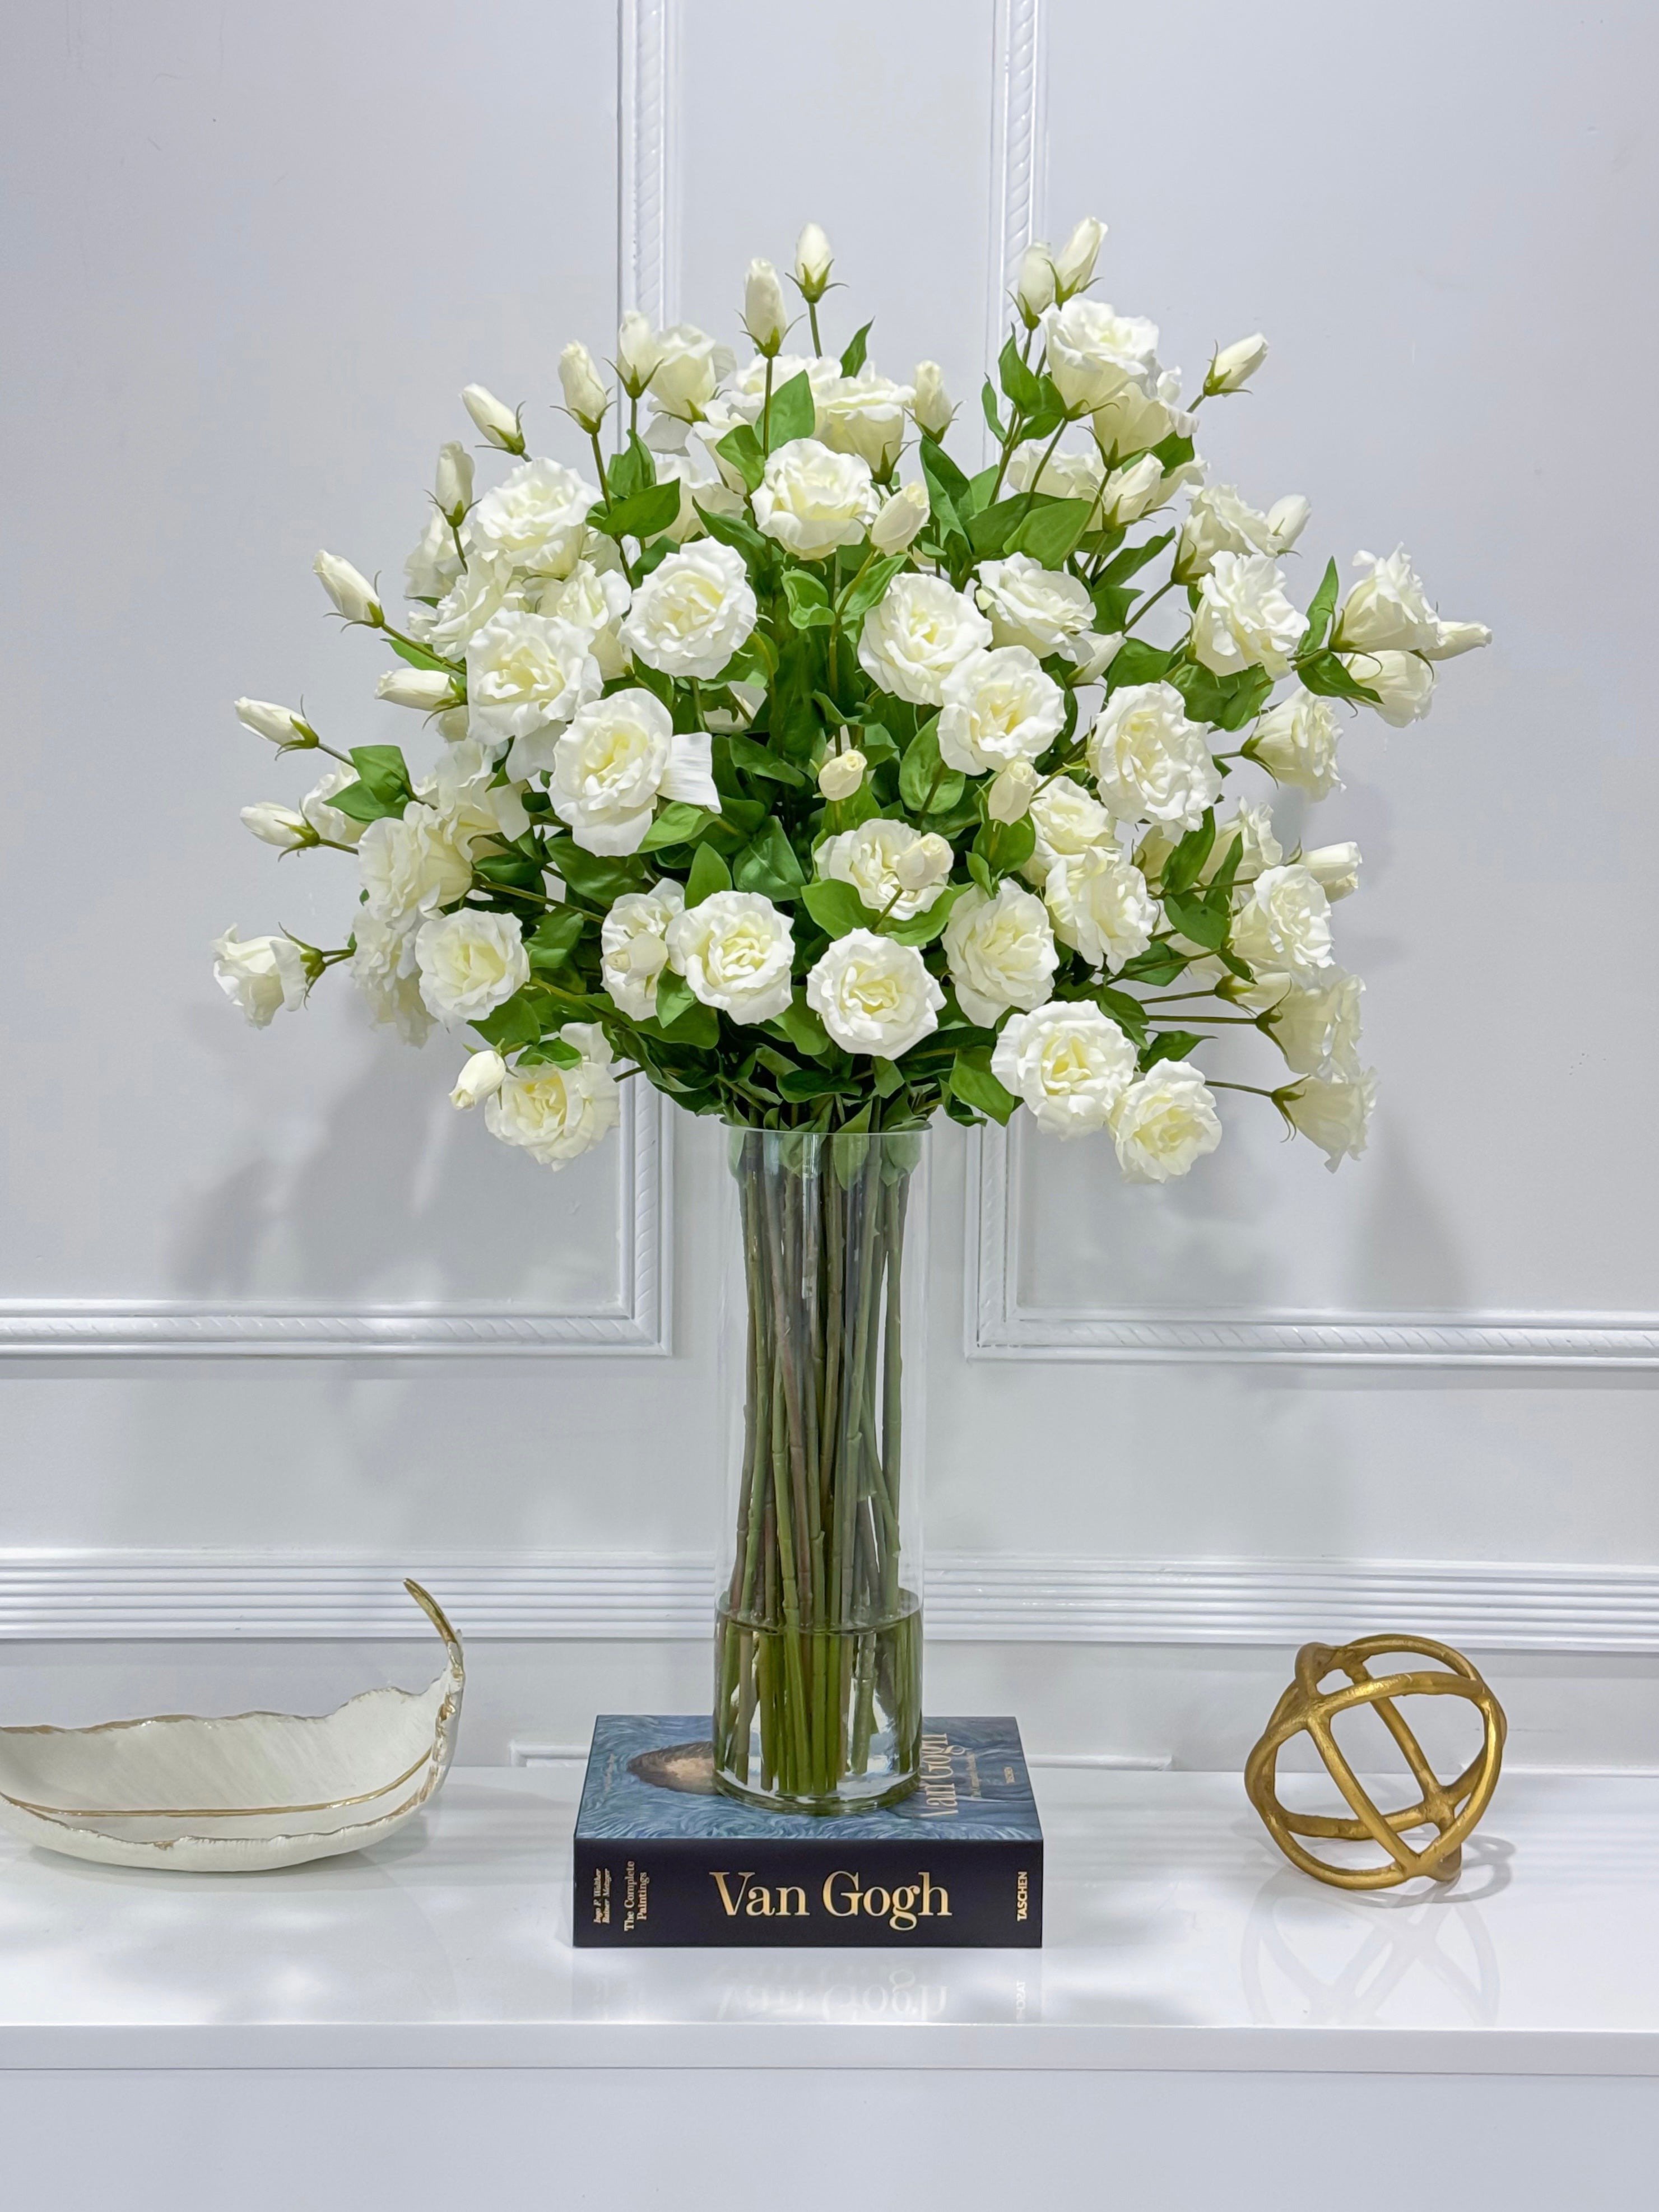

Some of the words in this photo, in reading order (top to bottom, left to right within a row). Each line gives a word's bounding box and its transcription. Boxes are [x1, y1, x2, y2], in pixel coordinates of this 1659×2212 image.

[624, 1861, 638, 1908] Complete
[636, 1872, 650, 1921] Paintings
[709, 1872, 810, 1916] Van
[822, 1871, 952, 1931] Gogh
[1017, 1871, 1028, 1922] TASCHEN
[624, 1911, 634, 1931] The
